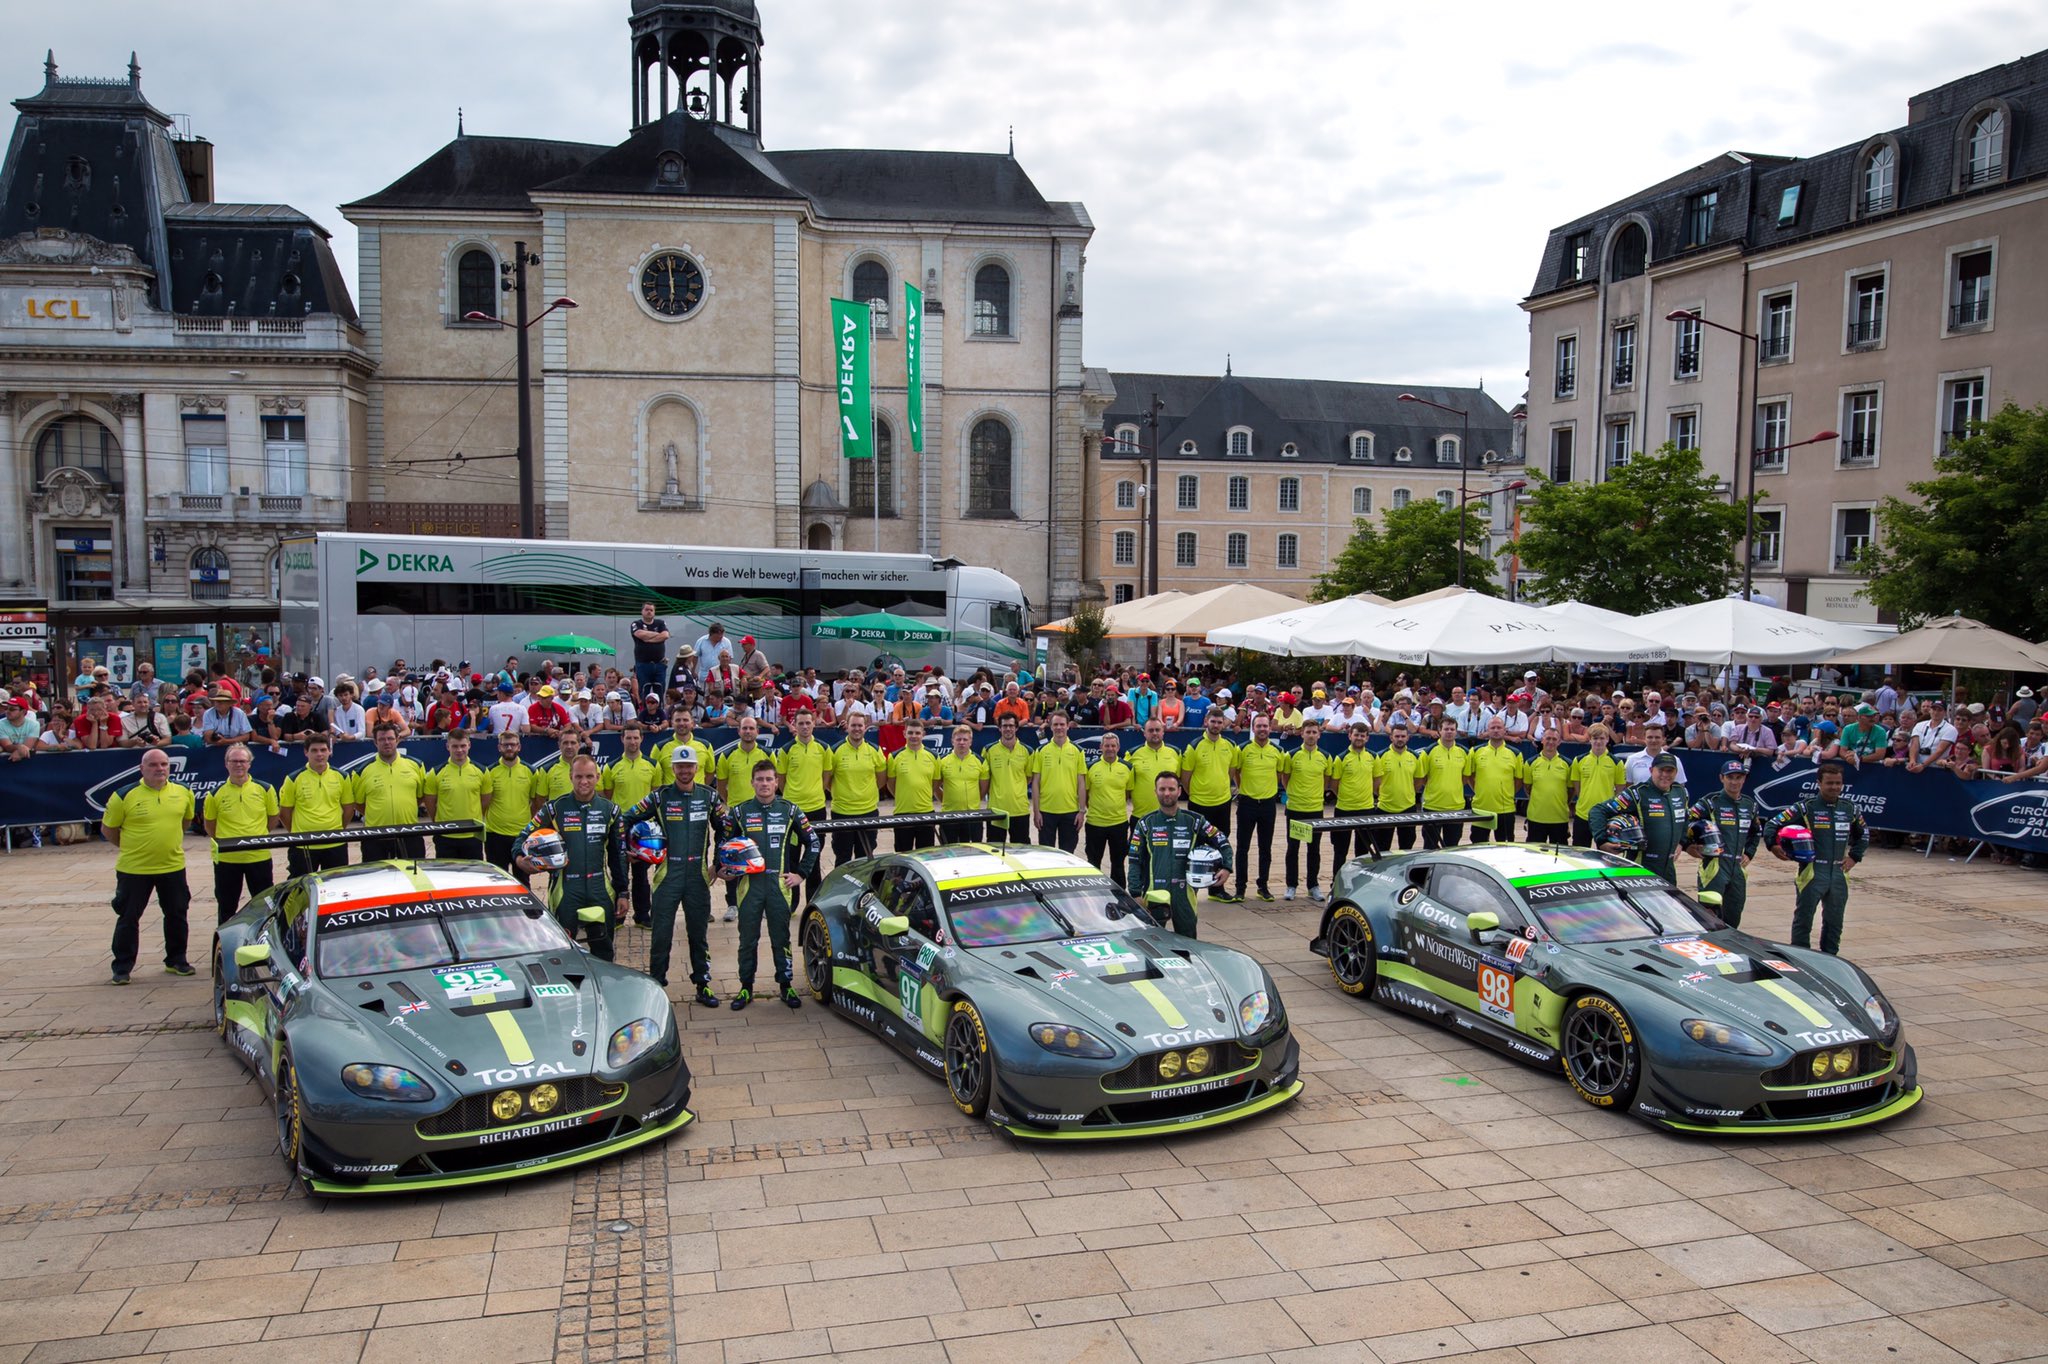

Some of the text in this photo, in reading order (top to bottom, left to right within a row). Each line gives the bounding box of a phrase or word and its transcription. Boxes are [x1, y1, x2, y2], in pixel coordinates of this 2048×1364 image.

[27, 298, 91, 319] LCL
[387, 553, 454, 572] DEKRA
[685, 566, 909, 583] Was die Welt bewegt, machen wir sicher.
[861, 630, 886, 639] DEKRA
[911, 631, 933, 640] DEKRA
[1487, 621, 1555, 633] PAUL
[1628, 650, 1667, 661] depuis 1889
[501, 713, 513, 731] 7
[862, 816, 920, 825] MARTIN
[922, 812, 983, 821] RACING
[1311, 811, 1467, 827] ASTON MARTIN RACING
[2007, 816, 2044, 827] DES 24
[237, 822, 460, 846] ASTON MARTIN RACING
[949, 876, 1112, 902] ASTON MARTIN RACING
[1528, 884, 1575, 899] ASTON
[1628, 878, 1670, 888] RACING
[324, 895, 534, 928] ASTON MARTIN RACING
[1418, 901, 1458, 929] TOTAL
[919, 945, 936, 967] PRO
[1072, 942, 1117, 958] 97
[1426, 937, 1479, 973] NORTHWEST
[1507, 939, 1529, 960] AM
[1158, 957, 1185, 969] PRO
[443, 969, 505, 989] 95
[1481, 968, 1510, 1009] 98
[536, 986, 569, 996] PRO
[900, 973, 919, 1014] 97
[1488, 1005, 1510, 1019] WEC
[1588, 998, 1630, 1037] DUNLOP
[1143, 1027, 1225, 1049] TOTAL
[1795, 1027, 1870, 1047] TOTAL
[919, 1050, 944, 1069] DUNLOP
[1513, 1043, 1550, 1061] DUNLOP
[473, 1061, 577, 1086] TOTAL
[1150, 1077, 1230, 1099] RICHARD MILLE
[1807, 1079, 1874, 1098] RICHARD MILLE
[1036, 1112, 1084, 1121] DUNLOP
[1639, 1101, 1667, 1116] Ontime
[1694, 1108, 1744, 1117] DUNLOP
[479, 1116, 583, 1144] RICHARD MILLE
[342, 1164, 399, 1172] DUNLOP
